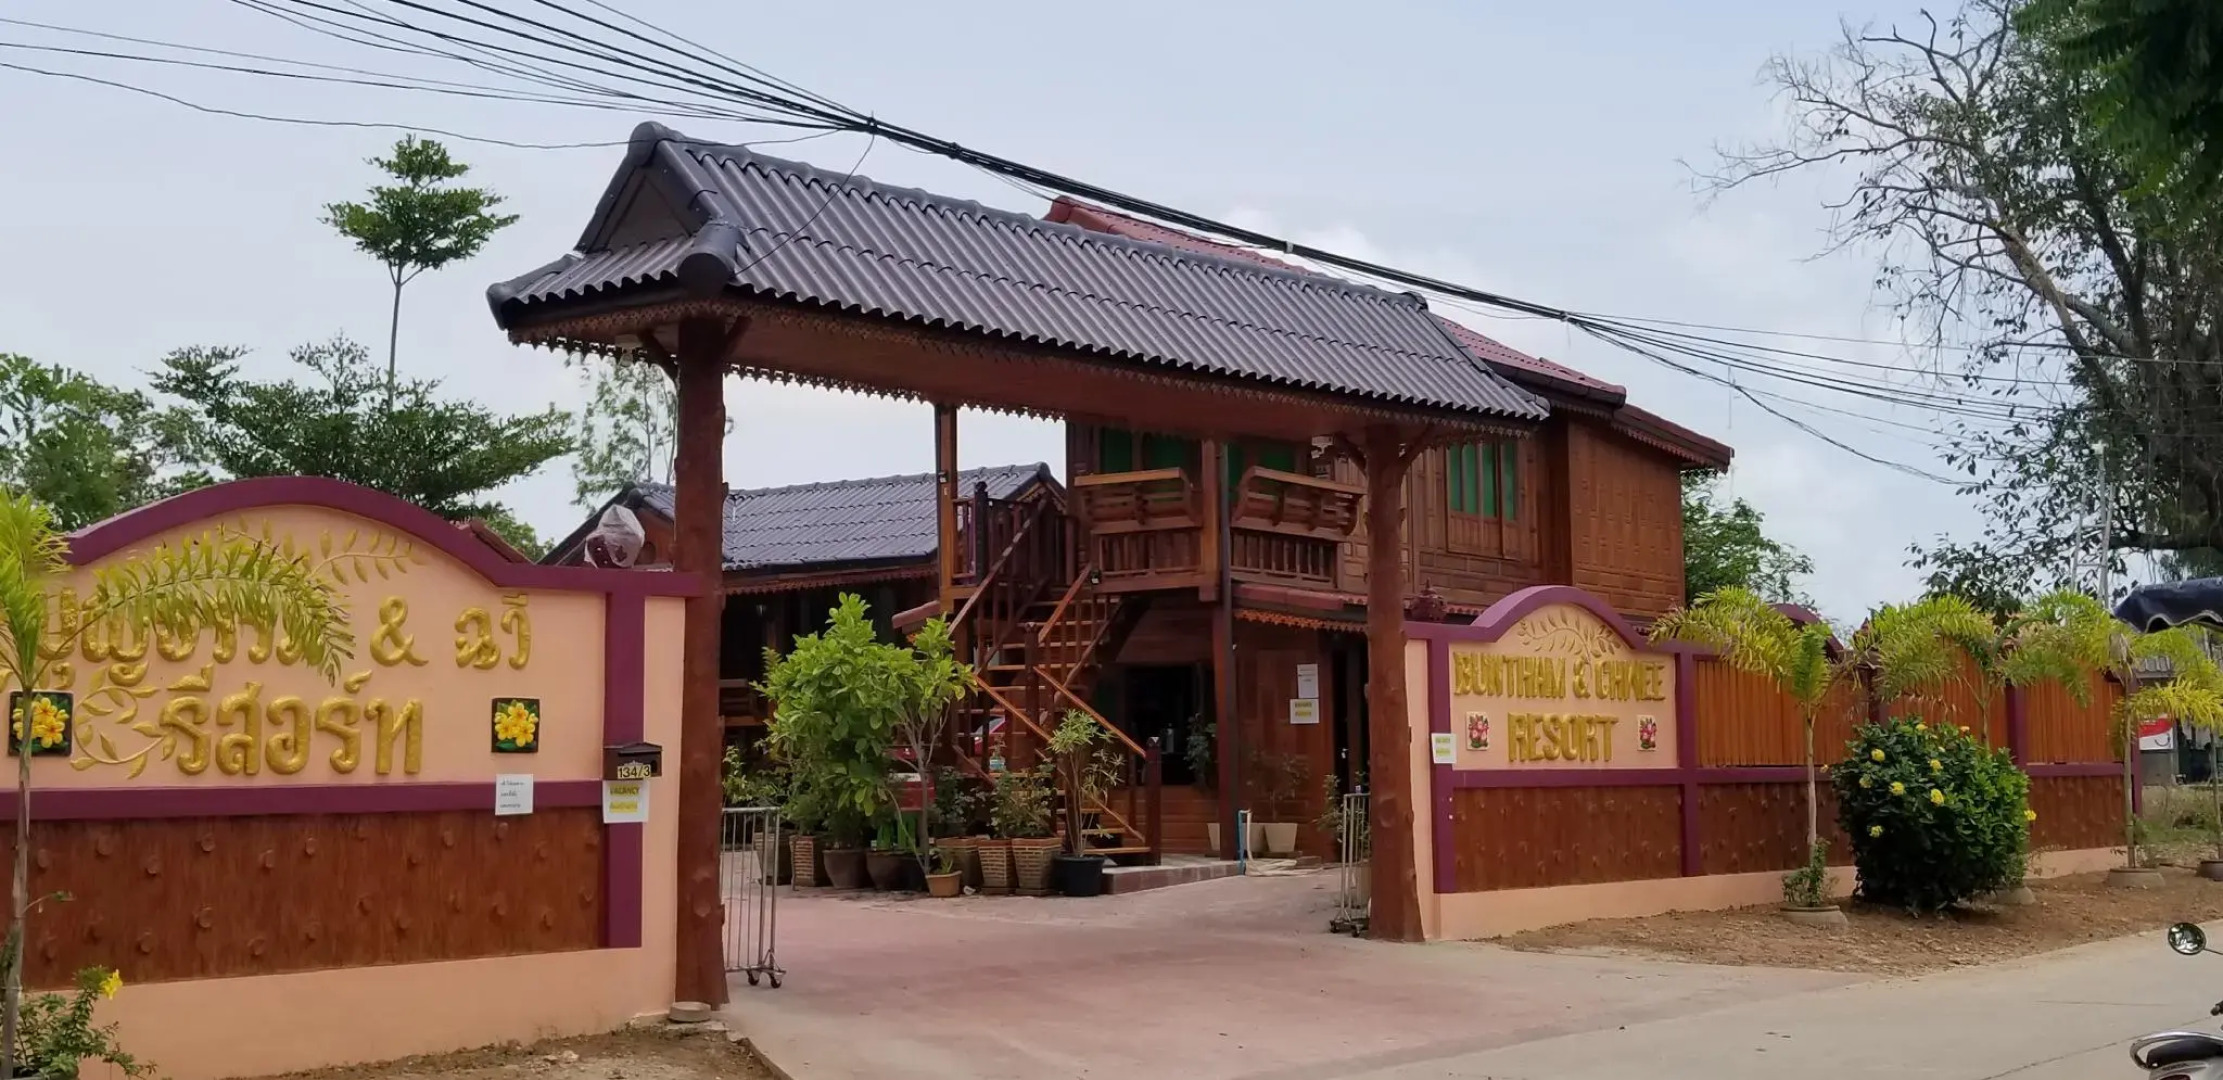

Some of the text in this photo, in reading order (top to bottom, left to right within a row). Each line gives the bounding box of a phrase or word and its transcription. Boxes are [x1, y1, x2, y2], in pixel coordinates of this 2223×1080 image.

[370, 596, 429, 667] &
[455, 593, 531, 670] ฉวี
[1453, 652, 1566, 699] BUNTHAM
[1572, 656, 1591, 698] &
[159, 660, 422, 774] รีสอร์ท
[1507, 712, 1619, 762] RESORT
[618, 765, 650, 778] 134/3
